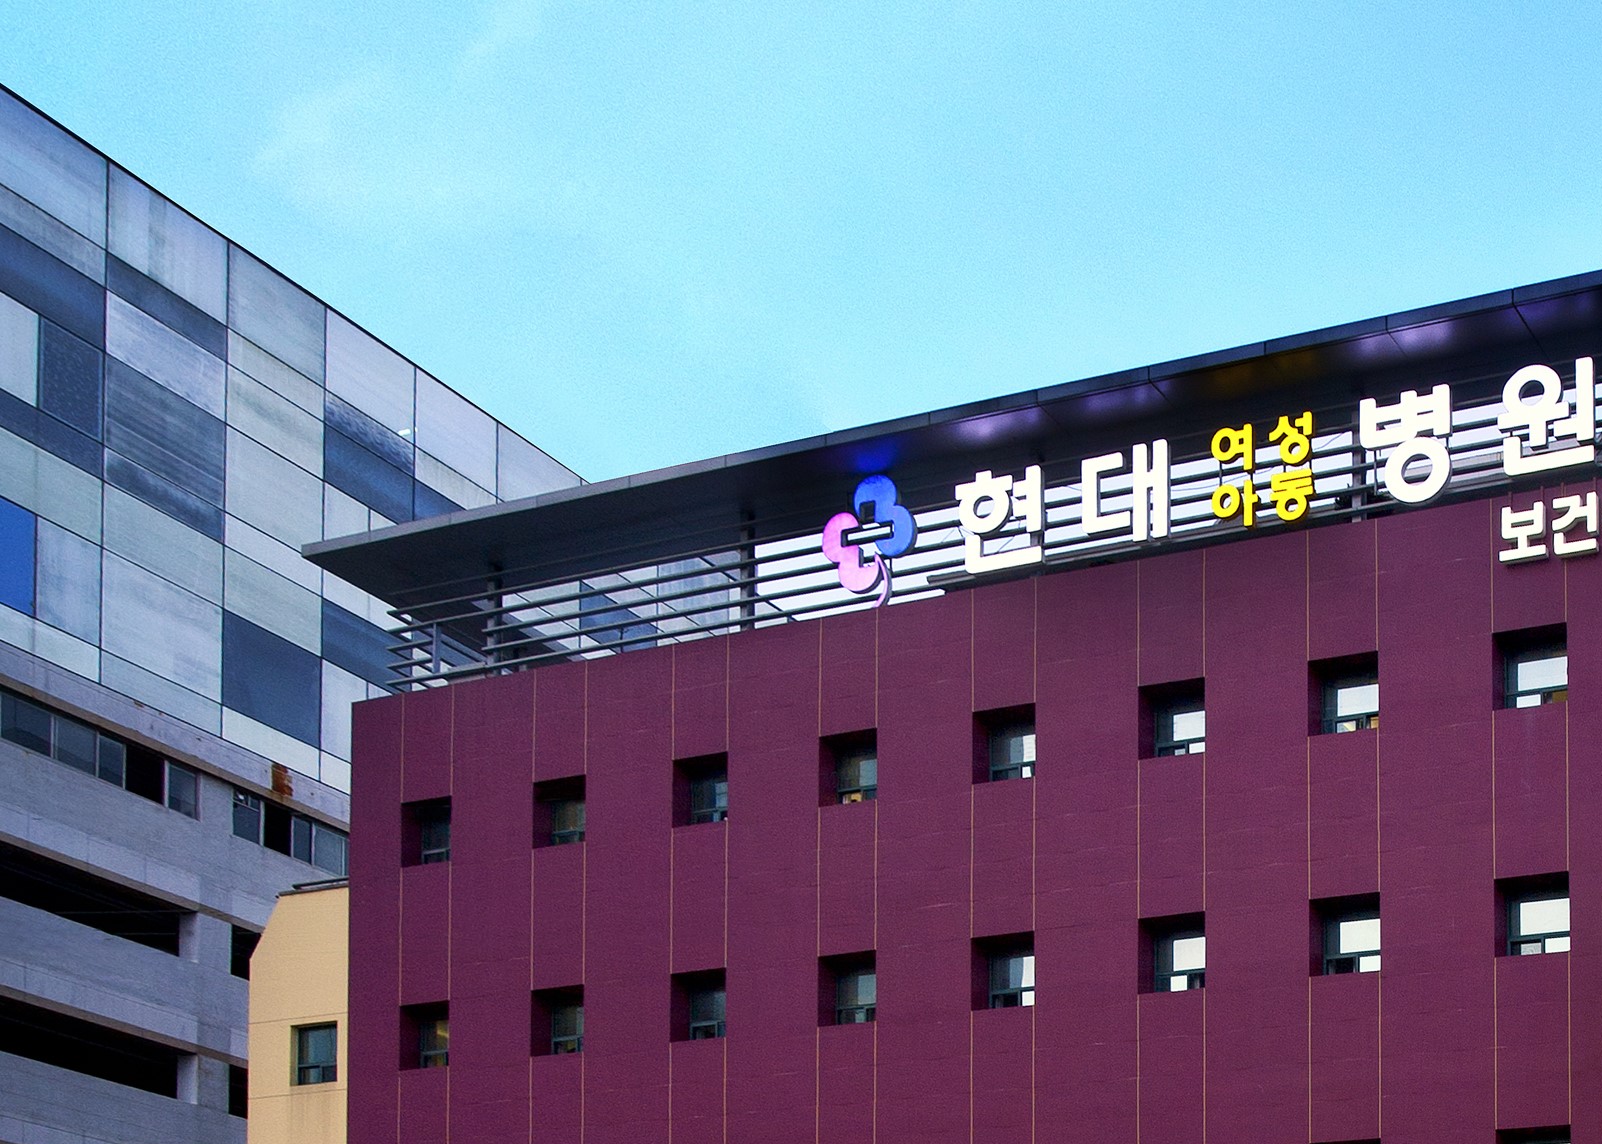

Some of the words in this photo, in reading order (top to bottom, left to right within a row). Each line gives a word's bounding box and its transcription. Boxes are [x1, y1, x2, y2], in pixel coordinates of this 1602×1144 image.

[1209, 410, 1314, 474] 여성
[1359, 357, 1601, 505] 병원
[954, 438, 1171, 577] 현대
[1209, 464, 1318, 532] 아동
